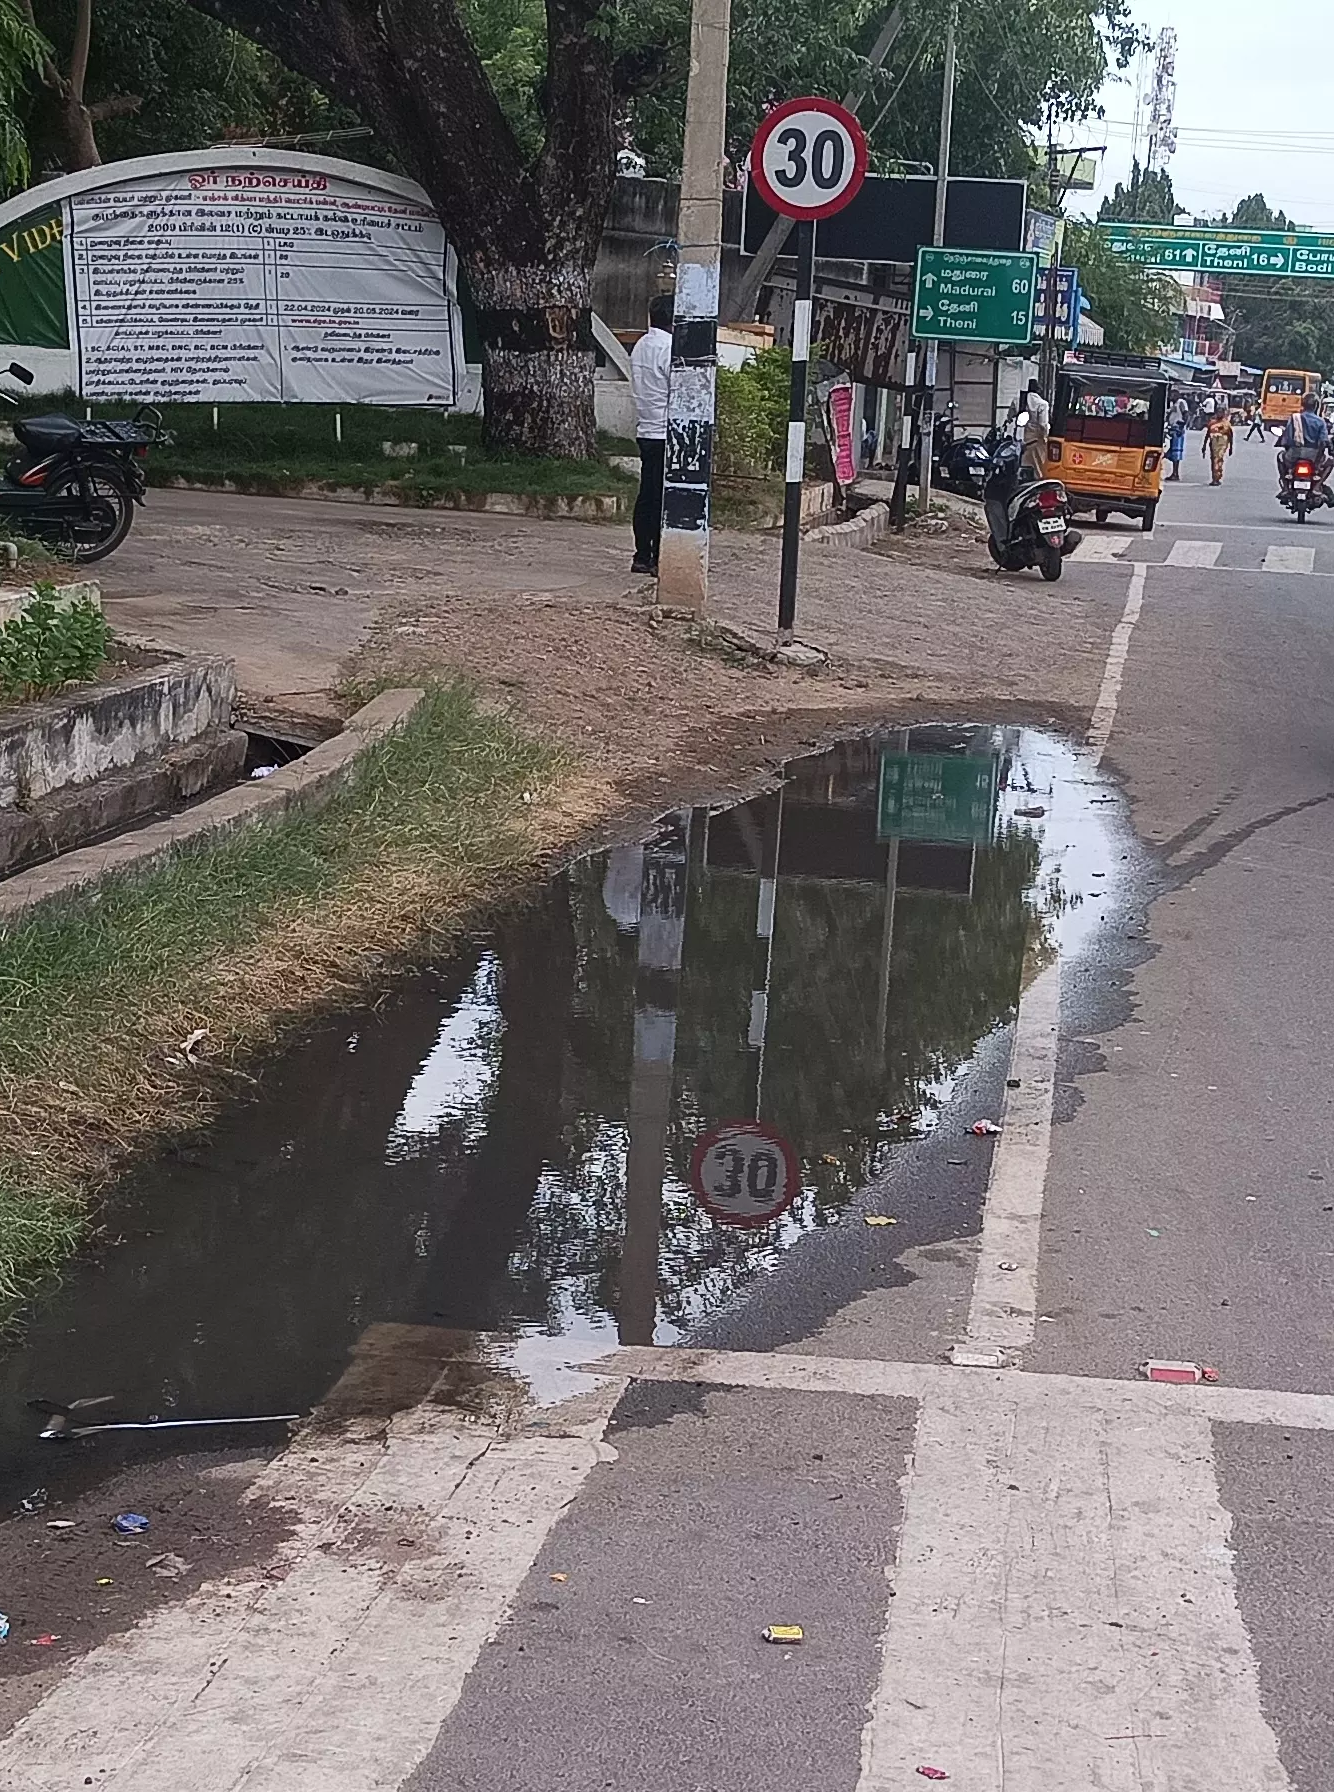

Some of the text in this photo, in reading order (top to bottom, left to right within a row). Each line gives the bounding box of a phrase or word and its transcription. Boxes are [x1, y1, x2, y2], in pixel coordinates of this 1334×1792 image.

[775, 128, 844, 189] 30
[187, 170, 327, 192] ஓர் நற்செய்தி
[195, 208, 232, 217] இலவச
[234, 208, 273, 221] மற்றும்
[275, 210, 320, 222] கட்டாயக்
[393, 221, 424, 233] சட்டம்
[147, 223, 176, 233] 2009
[1164, 248, 1181, 261] 61
[1204, 243, 1251, 258] தேனி
[1204, 256, 1247, 268] Theni
[1250, 253, 1268, 266] 16
[940, 268, 989, 281] மதுரை
[1294, 261, 1332, 274] Bodi
[939, 279, 1029, 297] Madurai 60
[284, 304, 331, 313] 22.04.2024
[938, 299, 979, 315] தேனி
[937, 310, 1027, 329] Theni 15
